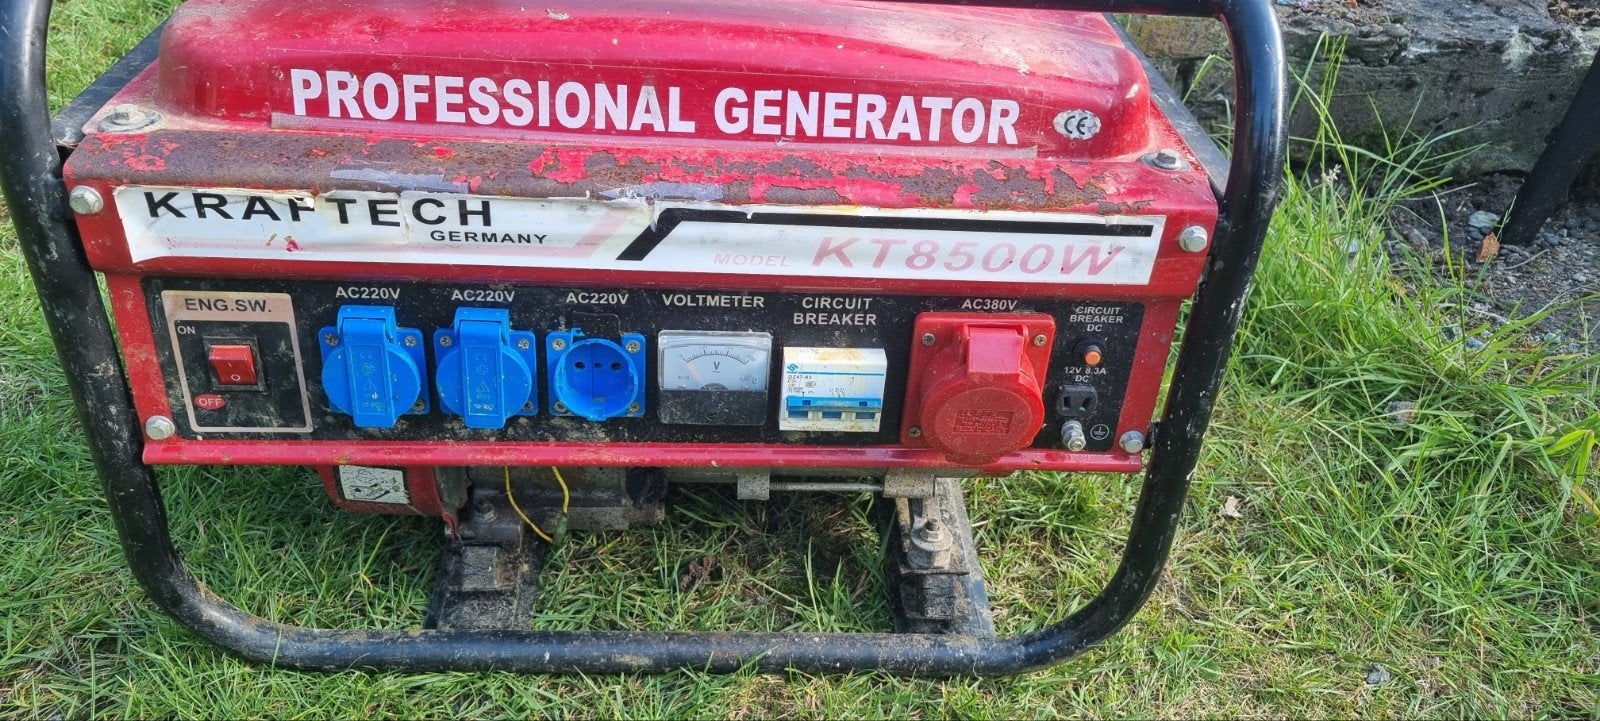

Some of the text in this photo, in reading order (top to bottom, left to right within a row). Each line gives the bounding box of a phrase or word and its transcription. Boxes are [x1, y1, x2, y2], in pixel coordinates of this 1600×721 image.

[290, 68, 1020, 144] PROFESSIONAL GENERATOR
[1064, 115, 1088, 135] CE
[143, 191, 492, 227] KRAFTECH
[430, 230, 548, 244] GERMANY
[713, 236, 1125, 276] MODEL KT8500W
[335, 287, 400, 299] AC220V
[451, 289, 515, 302] AC220V
[566, 292, 629, 304] AC220V
[184, 298, 272, 312] ENG.SW.
[662, 294, 765, 308] VOLTMETER
[802, 297, 873, 310] CIRCUIT
[961, 299, 1018, 310] AC380V
[1075, 306, 1121, 315] CIRCUIT
[793, 312, 877, 326] BREAKER
[1069, 315, 1124, 324] BREAKER
[177, 325, 196, 335] ON
[1086, 324, 1103, 332] DC
[1064, 366, 1107, 375] 12V 8.3A
[199, 397, 223, 406] OFF
